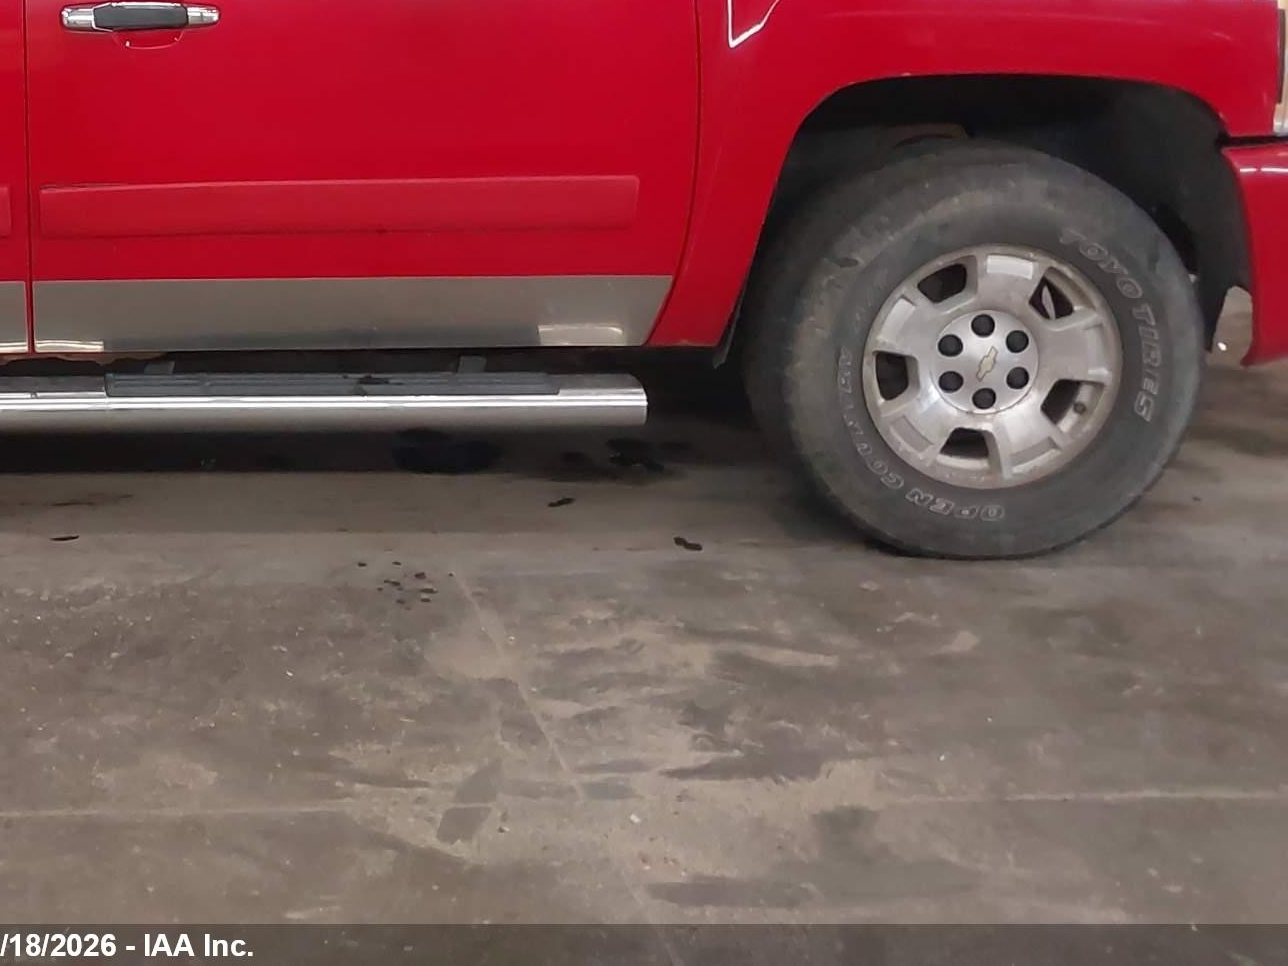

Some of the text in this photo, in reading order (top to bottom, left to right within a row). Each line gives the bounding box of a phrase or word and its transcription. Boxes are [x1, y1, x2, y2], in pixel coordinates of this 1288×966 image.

[1058, 227, 1163, 422] TOYO TIRES
[905, 487, 1006, 522] OPEN
